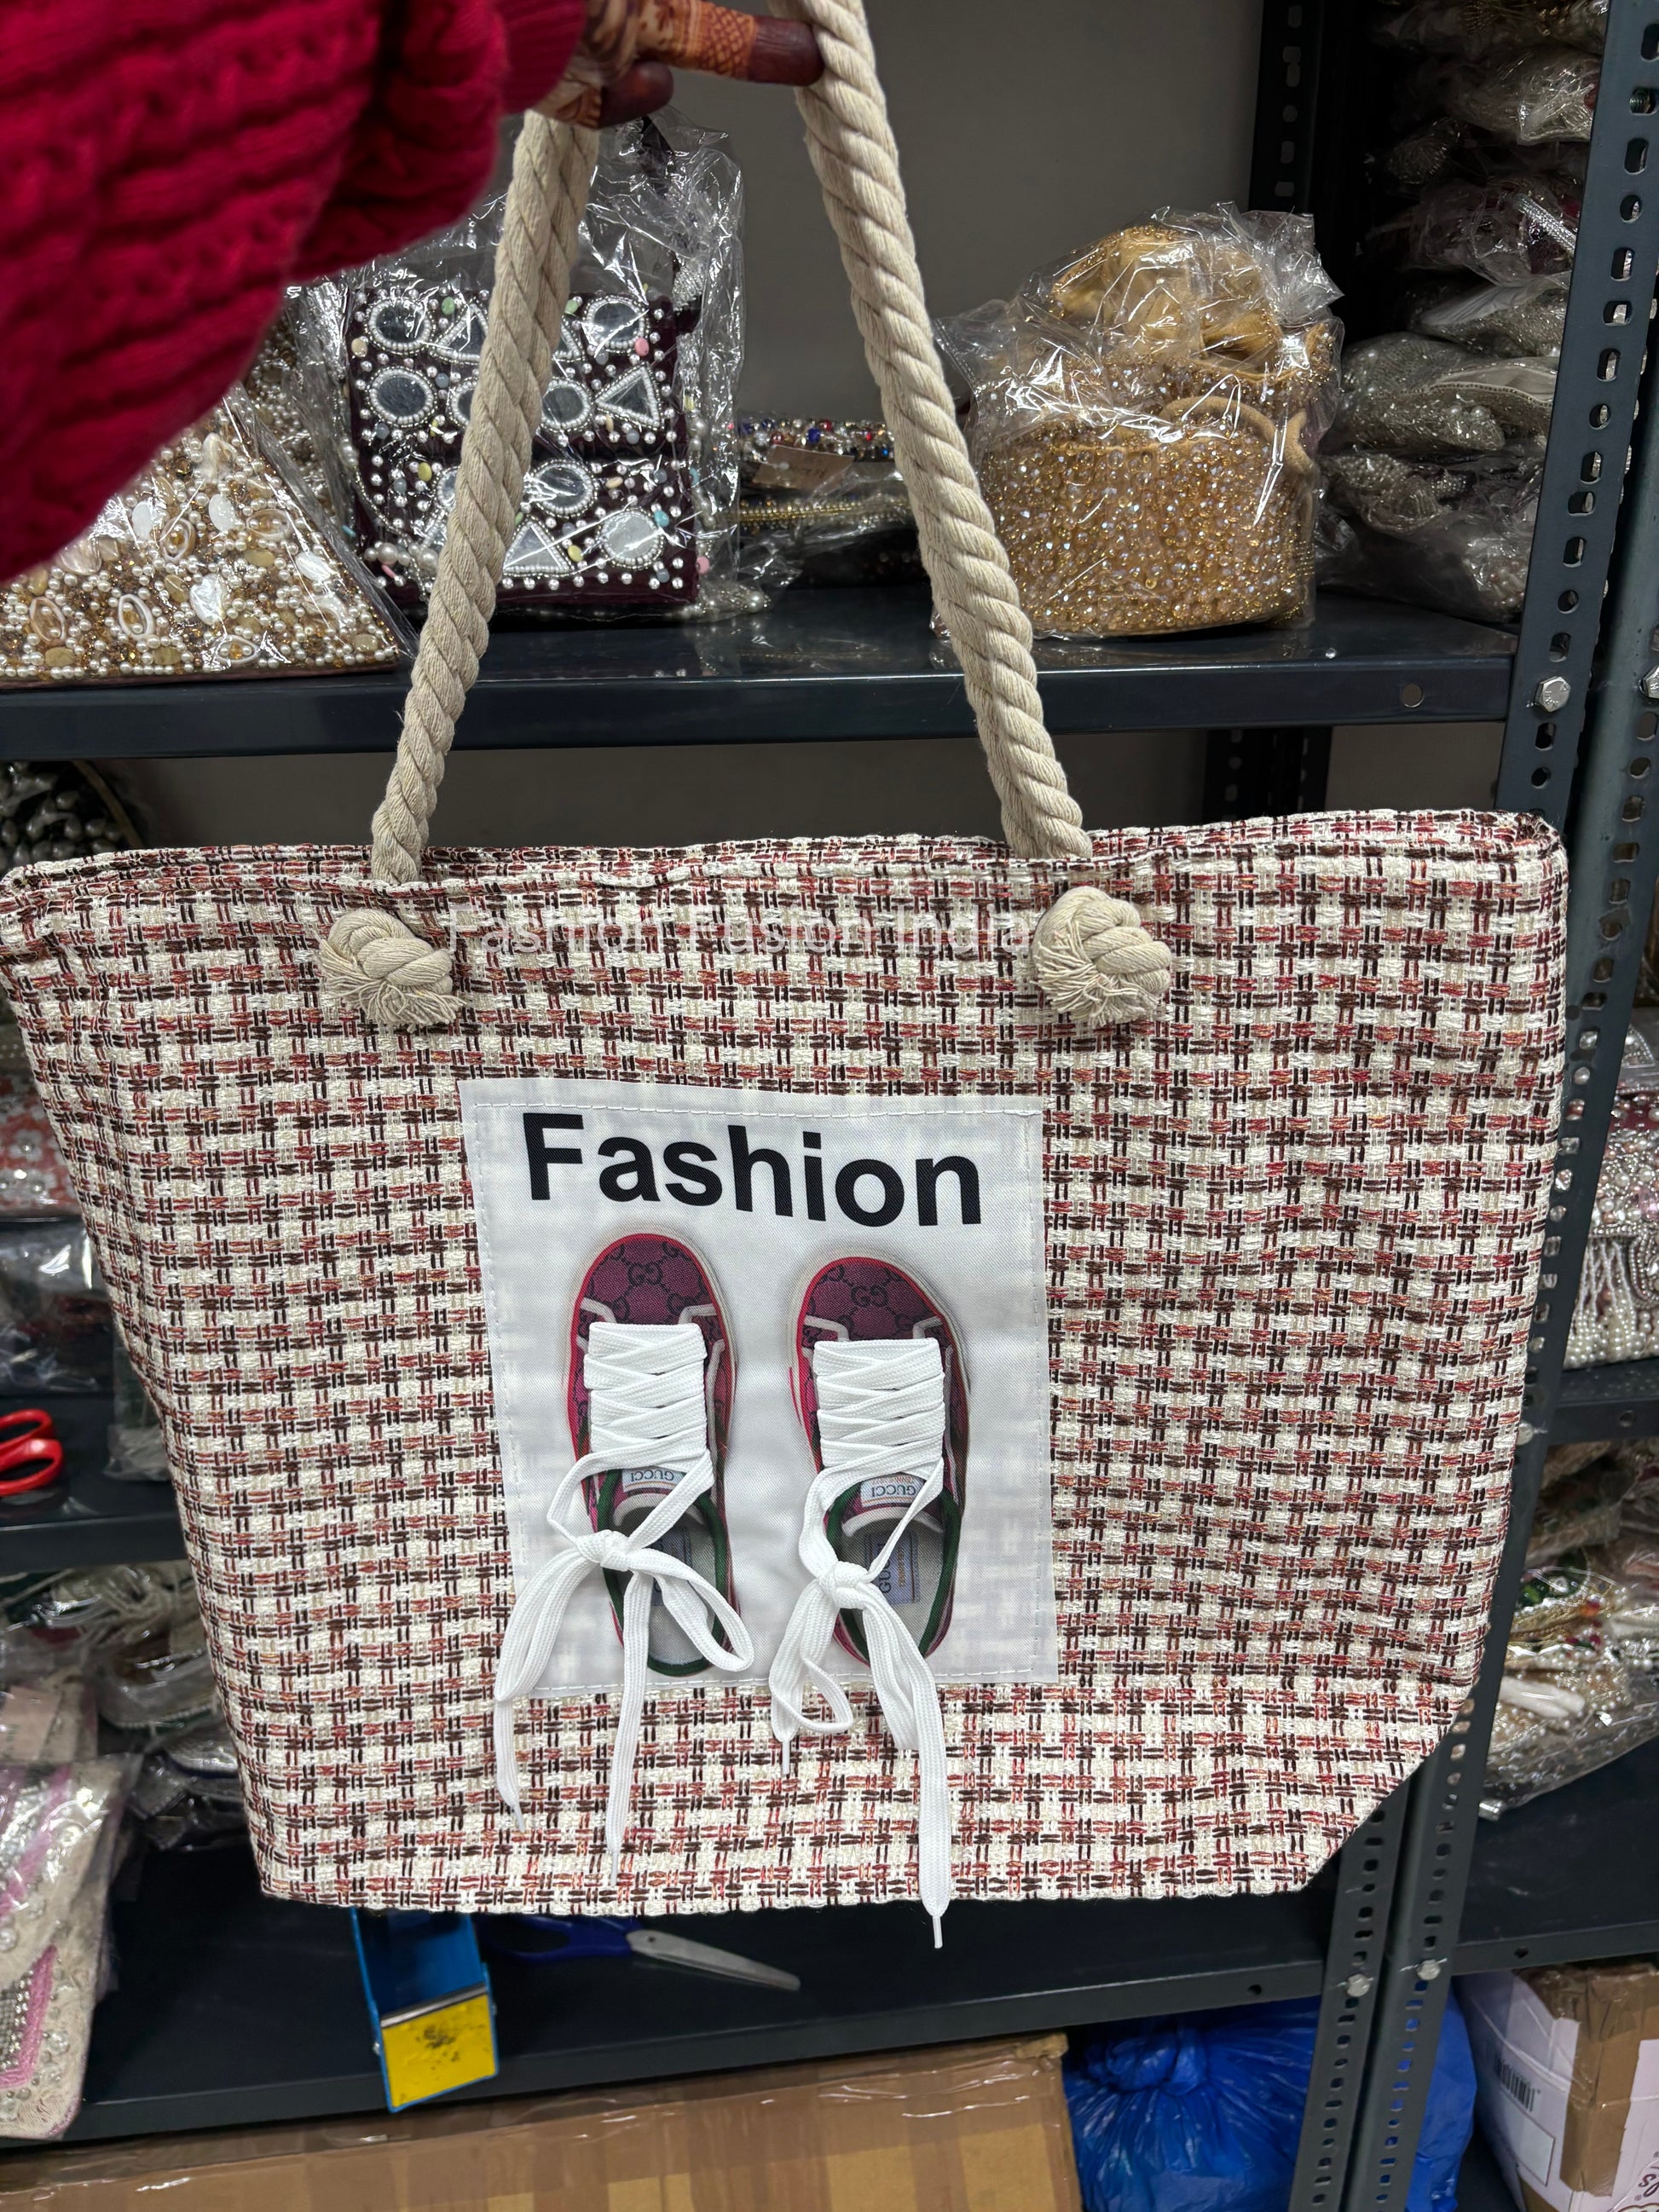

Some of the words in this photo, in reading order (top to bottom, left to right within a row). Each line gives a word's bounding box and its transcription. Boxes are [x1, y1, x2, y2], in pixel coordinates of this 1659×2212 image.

[523, 1112, 982, 1227] Fashion
[631, 1469, 674, 1482] GUCCI
[871, 1484, 916, 1498] GUCCI
